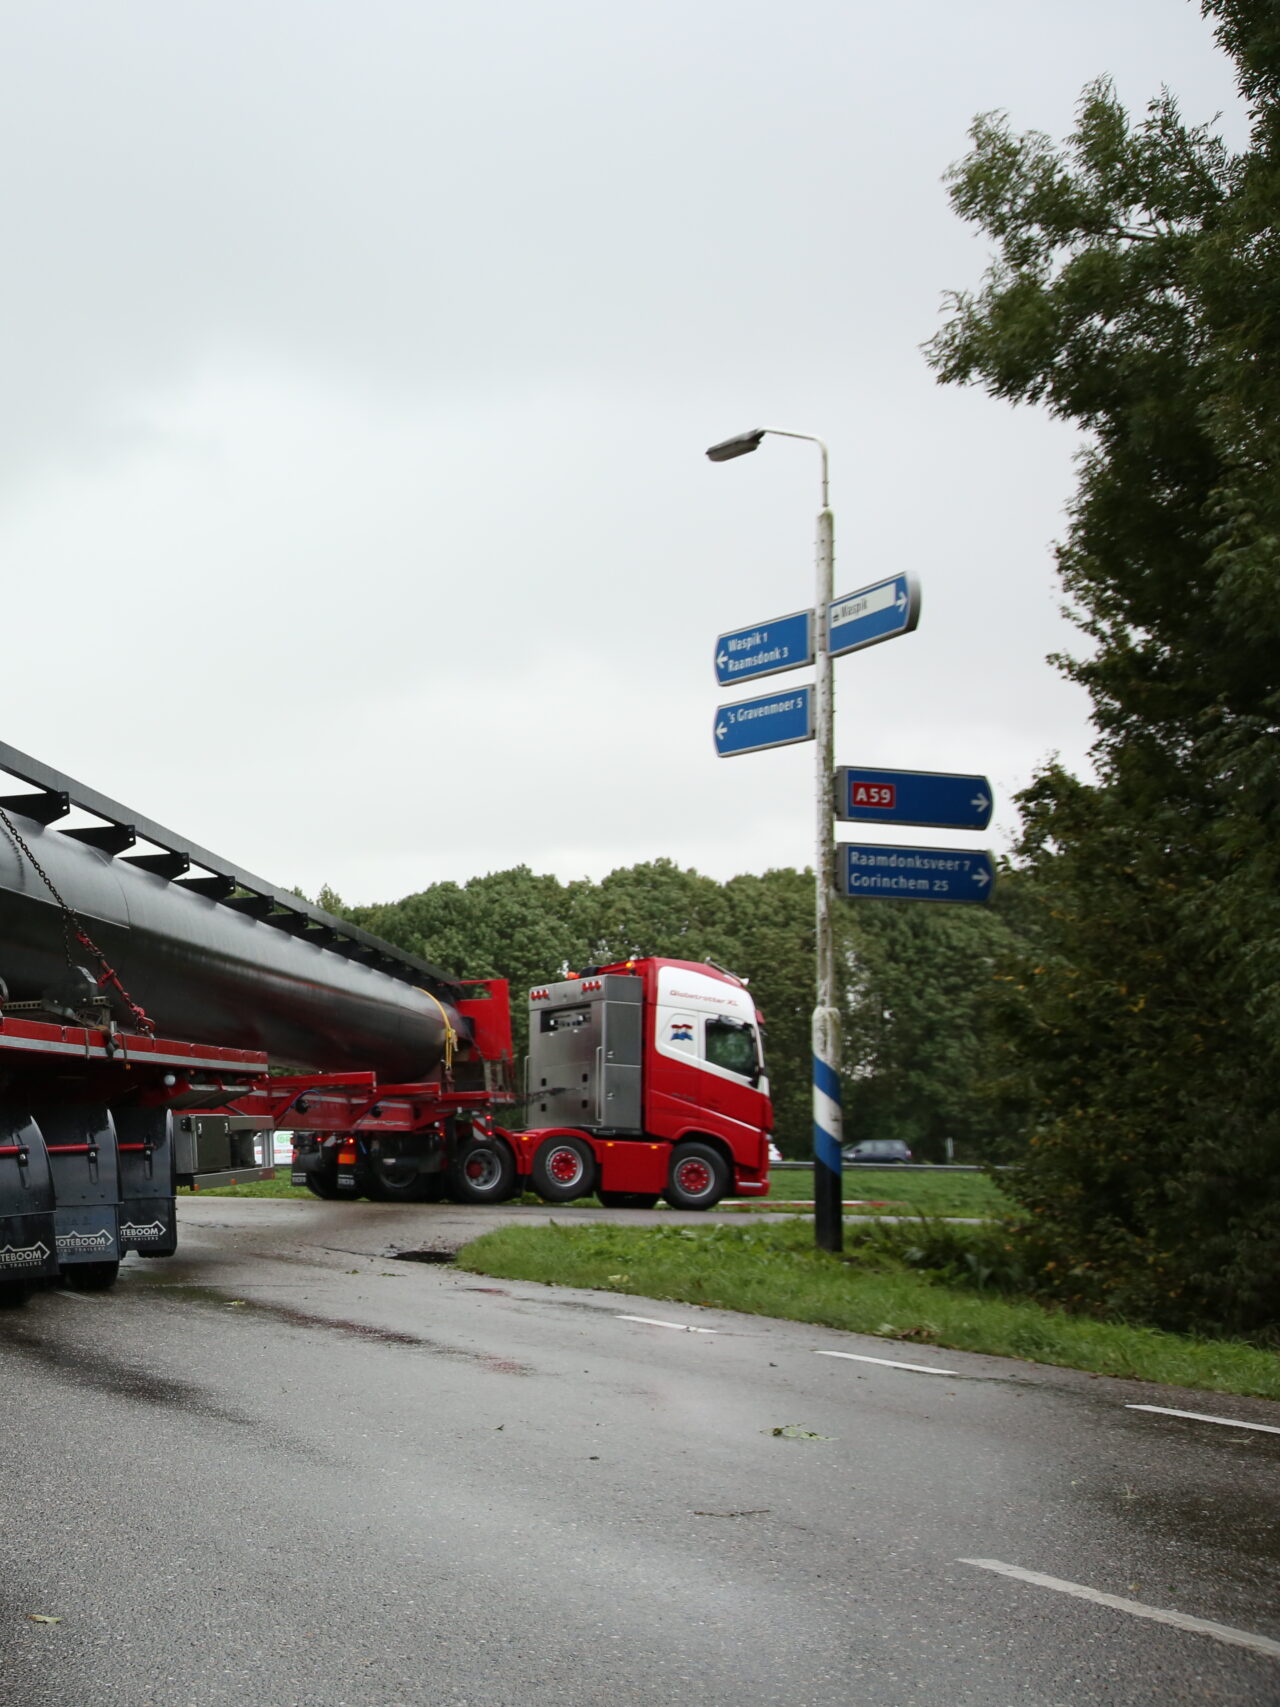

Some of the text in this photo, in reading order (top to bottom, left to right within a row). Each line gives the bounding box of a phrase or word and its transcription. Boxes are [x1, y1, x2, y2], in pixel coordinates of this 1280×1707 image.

[842, 599, 867, 617] Waspik
[728, 632, 768, 652] Waspik 1
[728, 647, 789, 672] Raamsdonk 3
[737, 699, 795, 721] Gravenmoer
[796, 697, 803, 708] 5
[856, 787, 891, 803] A59
[850, 851, 971, 871] Raamdonksveer 7
[850, 873, 949, 891] Gorinchem 25
[120, 1227, 158, 1236] TEBOOM
[55, 1237, 106, 1247] OTEBOOM
[9, 1260, 42, 1268] TRAILERS
